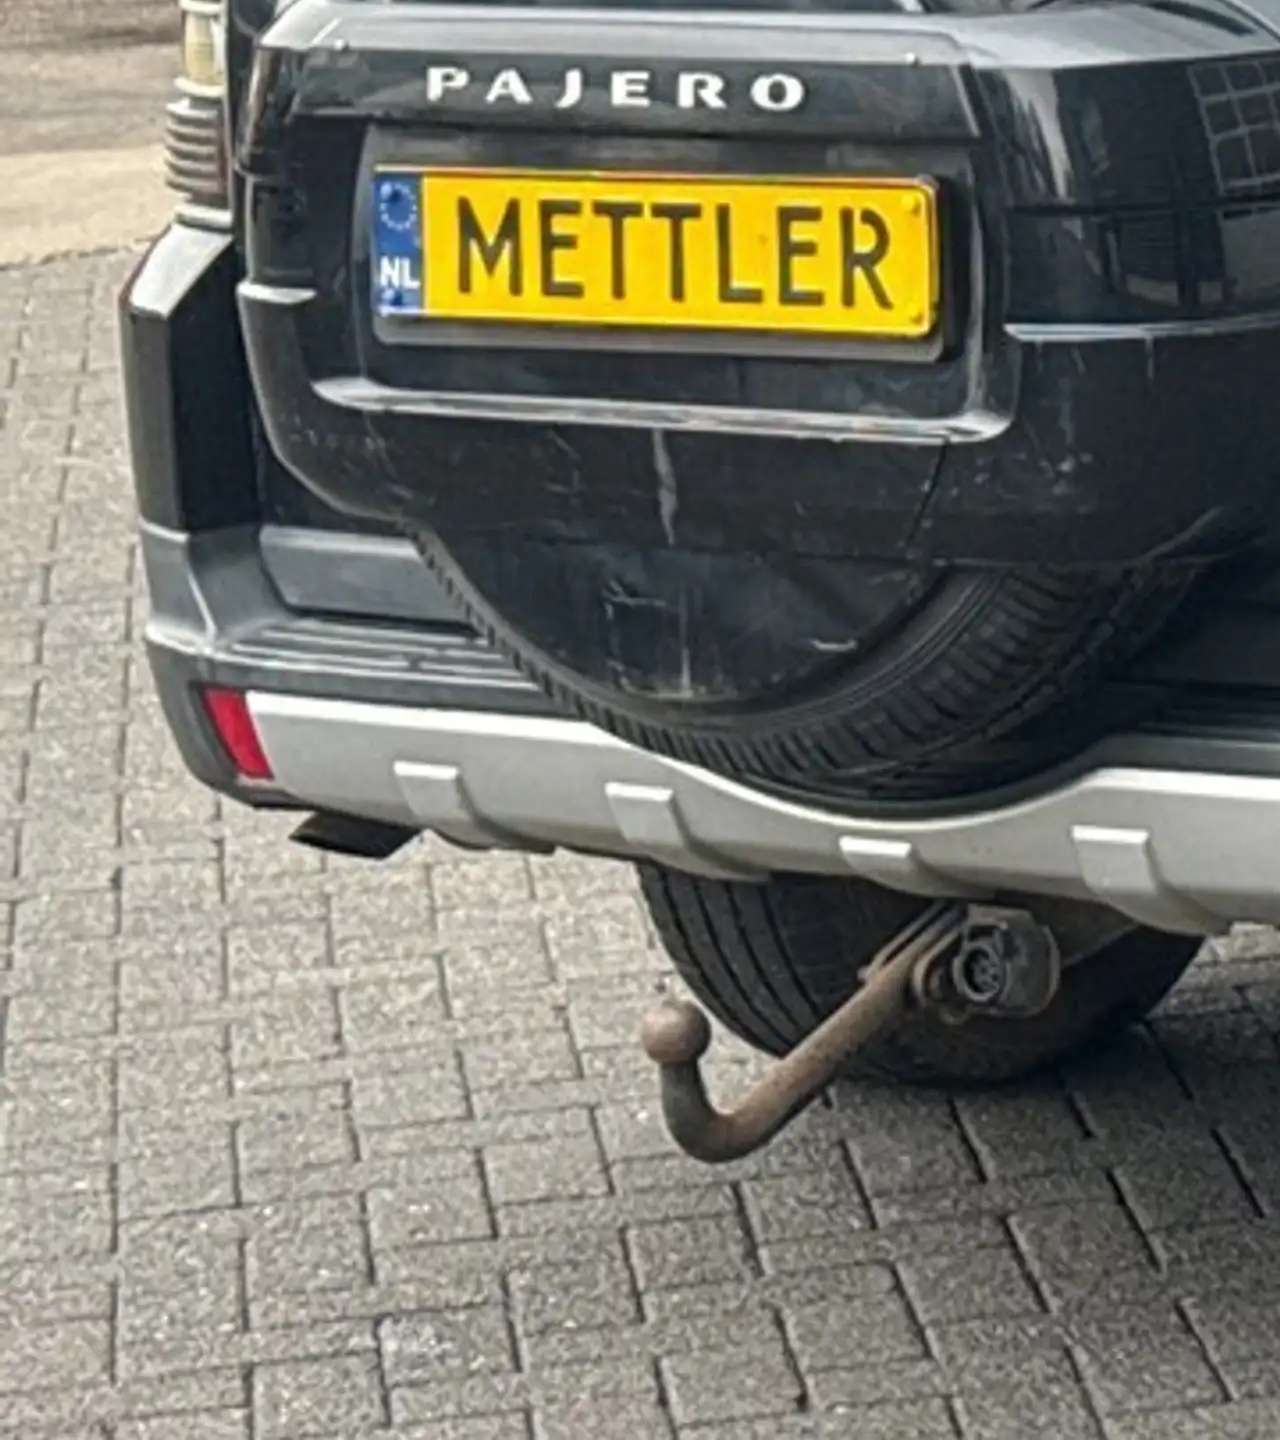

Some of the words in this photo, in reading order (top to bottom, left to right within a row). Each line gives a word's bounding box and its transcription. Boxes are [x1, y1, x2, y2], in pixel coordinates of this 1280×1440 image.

[426, 66, 806, 112] PAJERO
[379, 256, 420, 289] NL
[457, 195, 894, 312] METTLER
